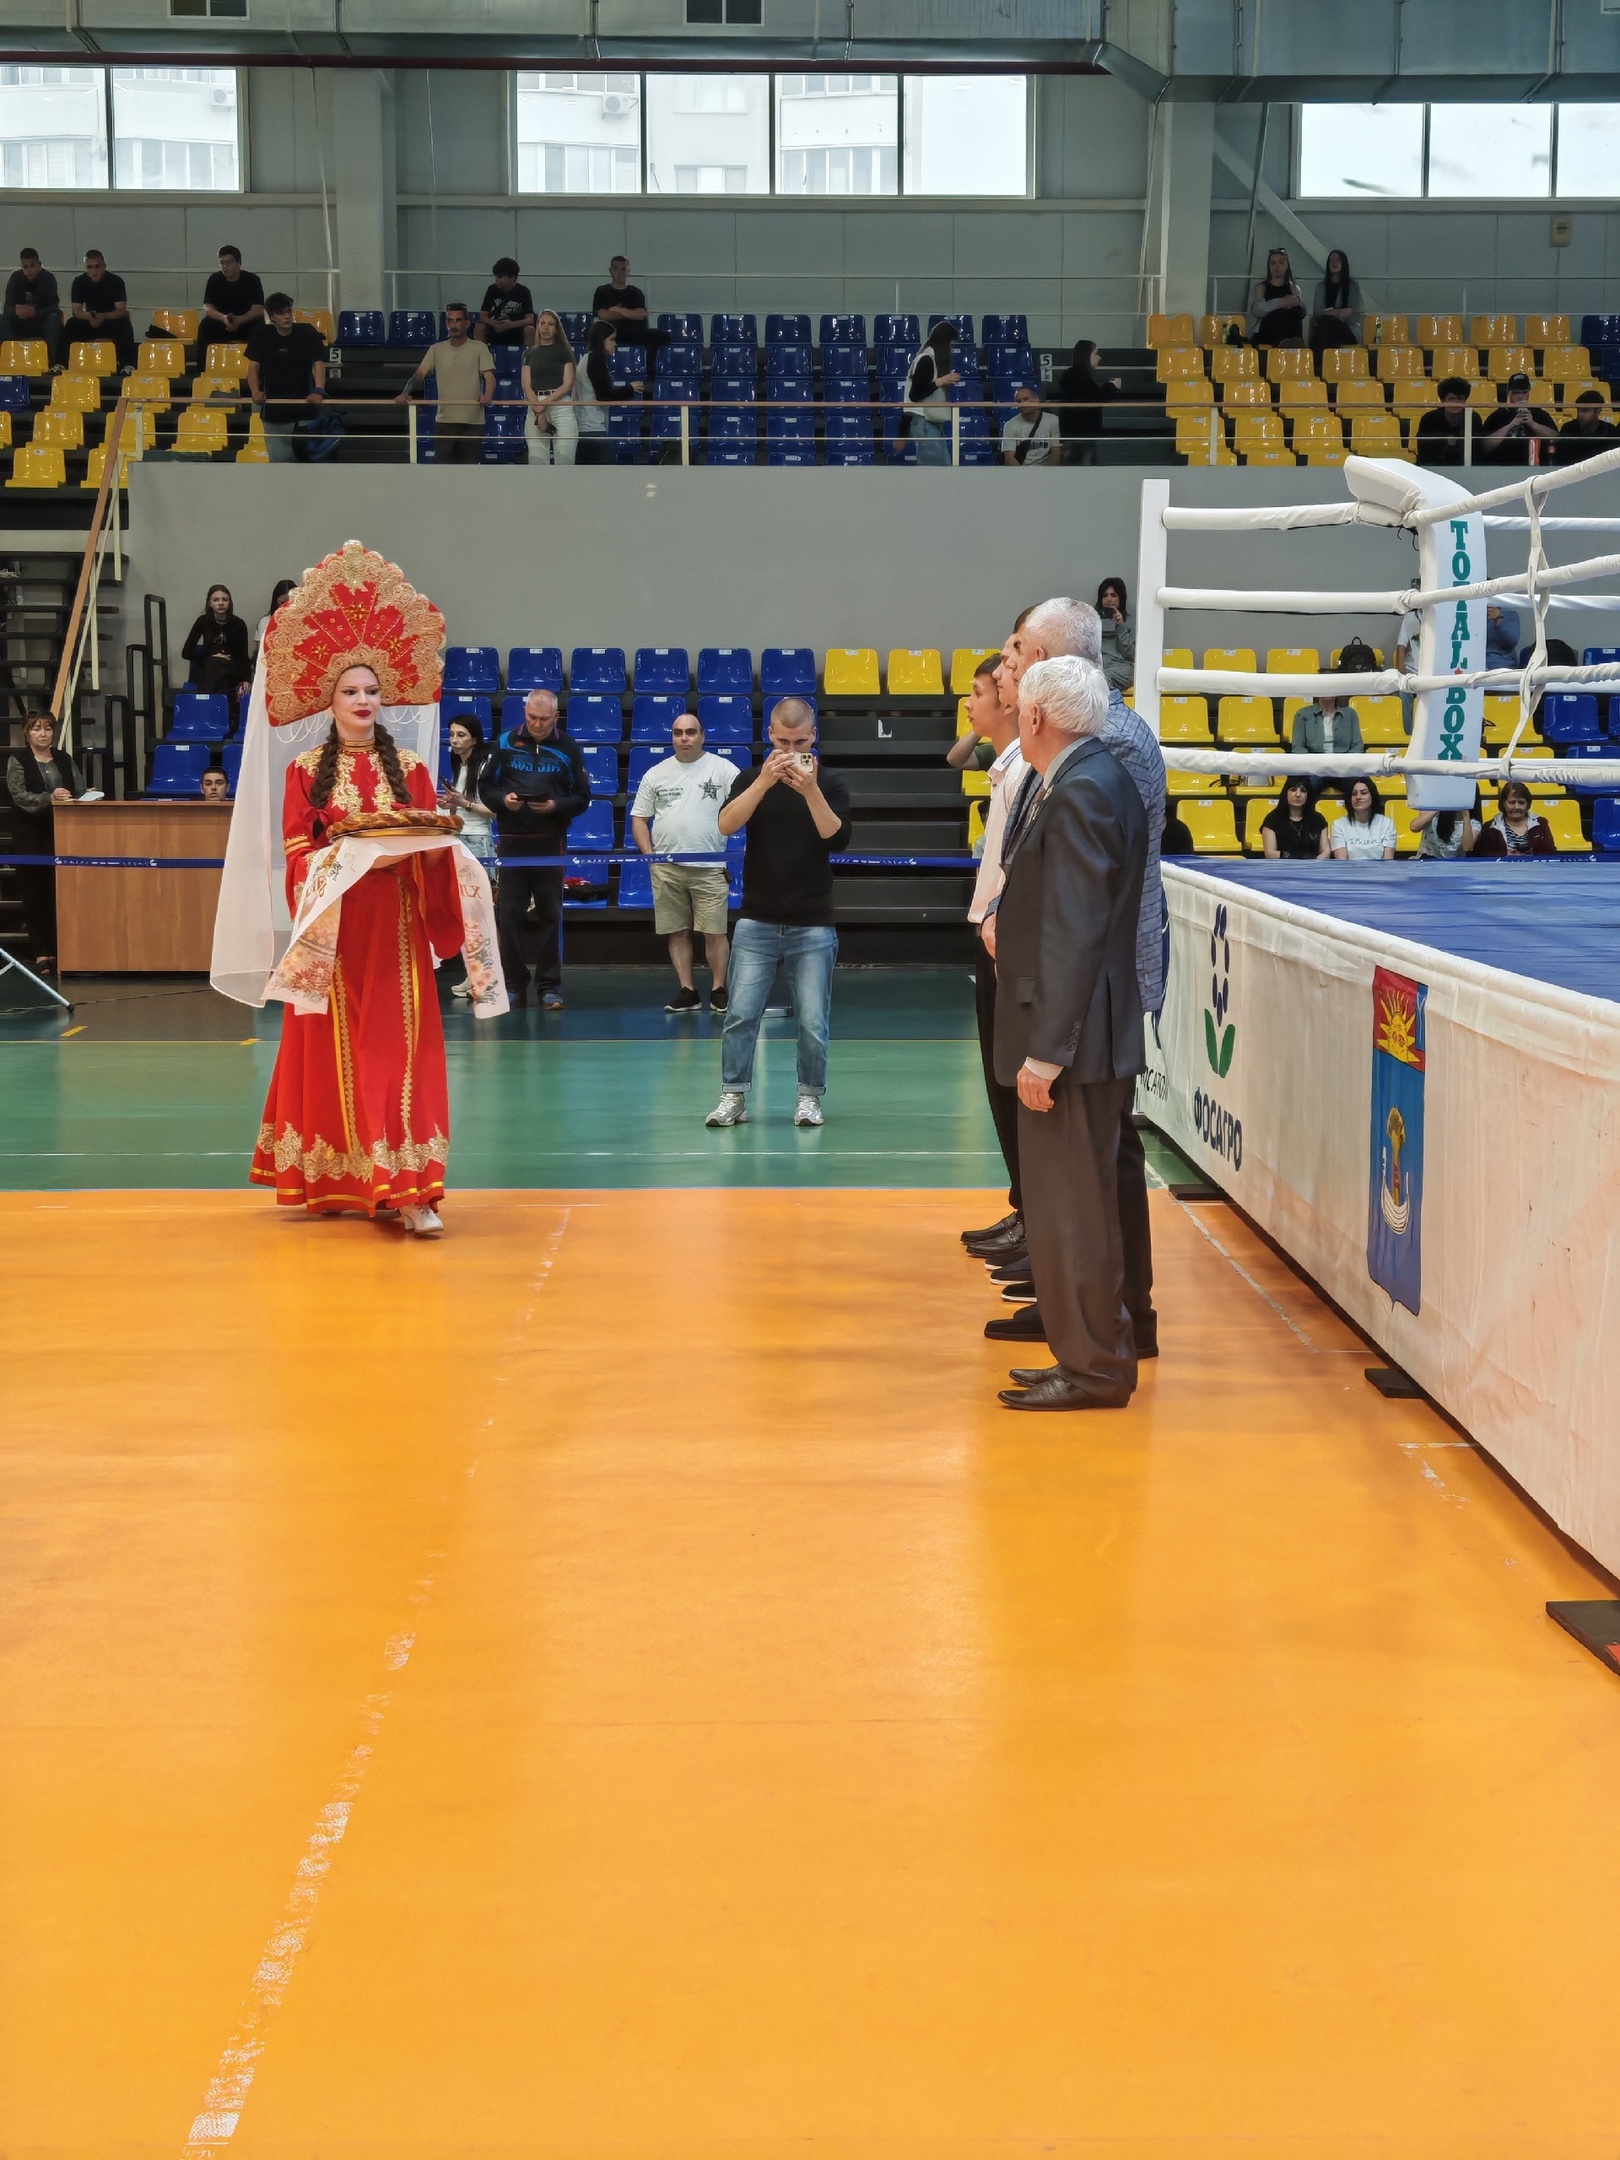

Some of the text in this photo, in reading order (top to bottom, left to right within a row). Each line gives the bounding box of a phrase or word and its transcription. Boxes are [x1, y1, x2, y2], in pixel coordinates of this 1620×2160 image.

[331, 349, 340, 360] 5
[1042, 354, 1051, 366] 5
[1438, 687, 1465, 761] BOX
[1194, 1086, 1242, 1171] ФОСАГРО
